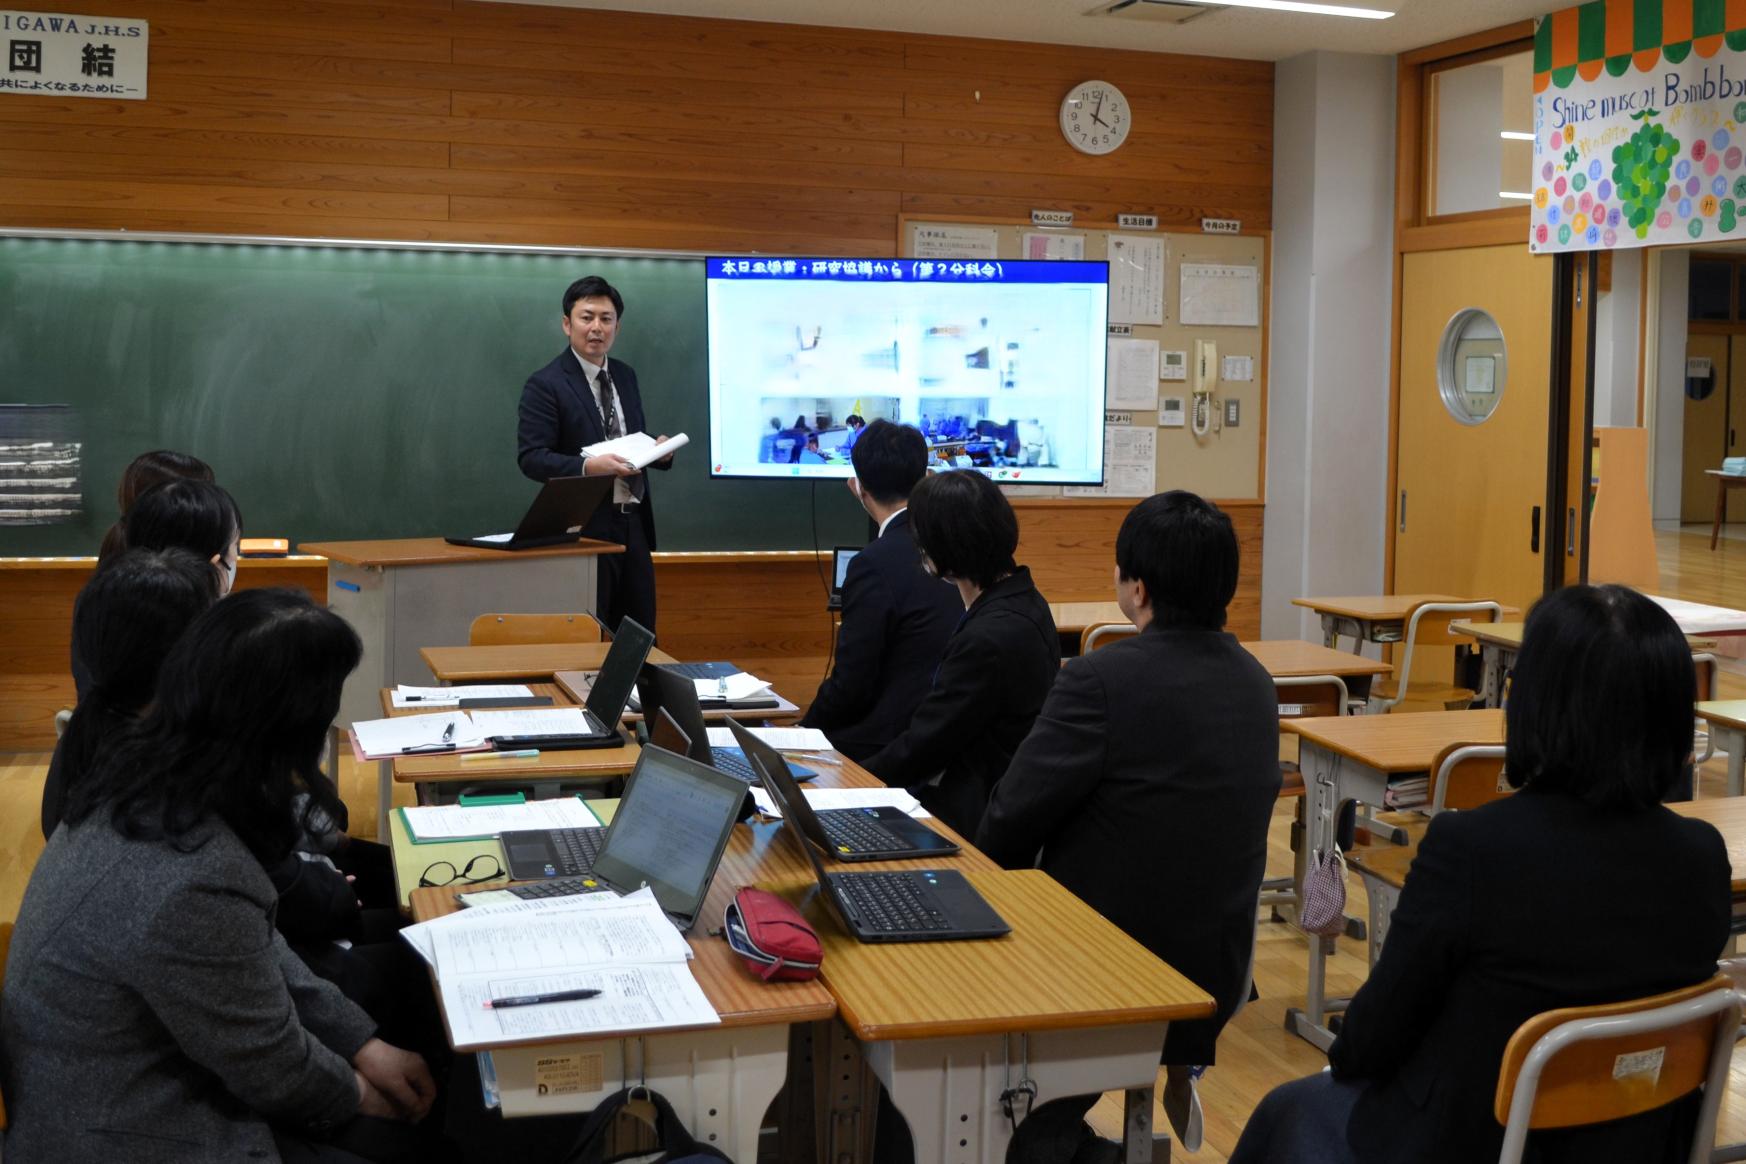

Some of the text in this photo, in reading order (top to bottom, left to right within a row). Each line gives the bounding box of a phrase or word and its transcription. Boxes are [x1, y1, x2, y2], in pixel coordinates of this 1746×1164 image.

[4, 15, 79, 34] IGAWA
[1552, 96, 1596, 129] Shine
[1664, 64, 1746, 107] Bombbo
[1111, 103, 1118, 112] 2
[1071, 112, 1077, 120] 9
[1113, 115, 1120, 123] 3
[1073, 124, 1080, 132] 8
[1110, 127, 1116, 135] 4
[1081, 133, 1087, 142] 7
[1091, 136, 1098, 145] 6
[1103, 135, 1109, 143] 5
